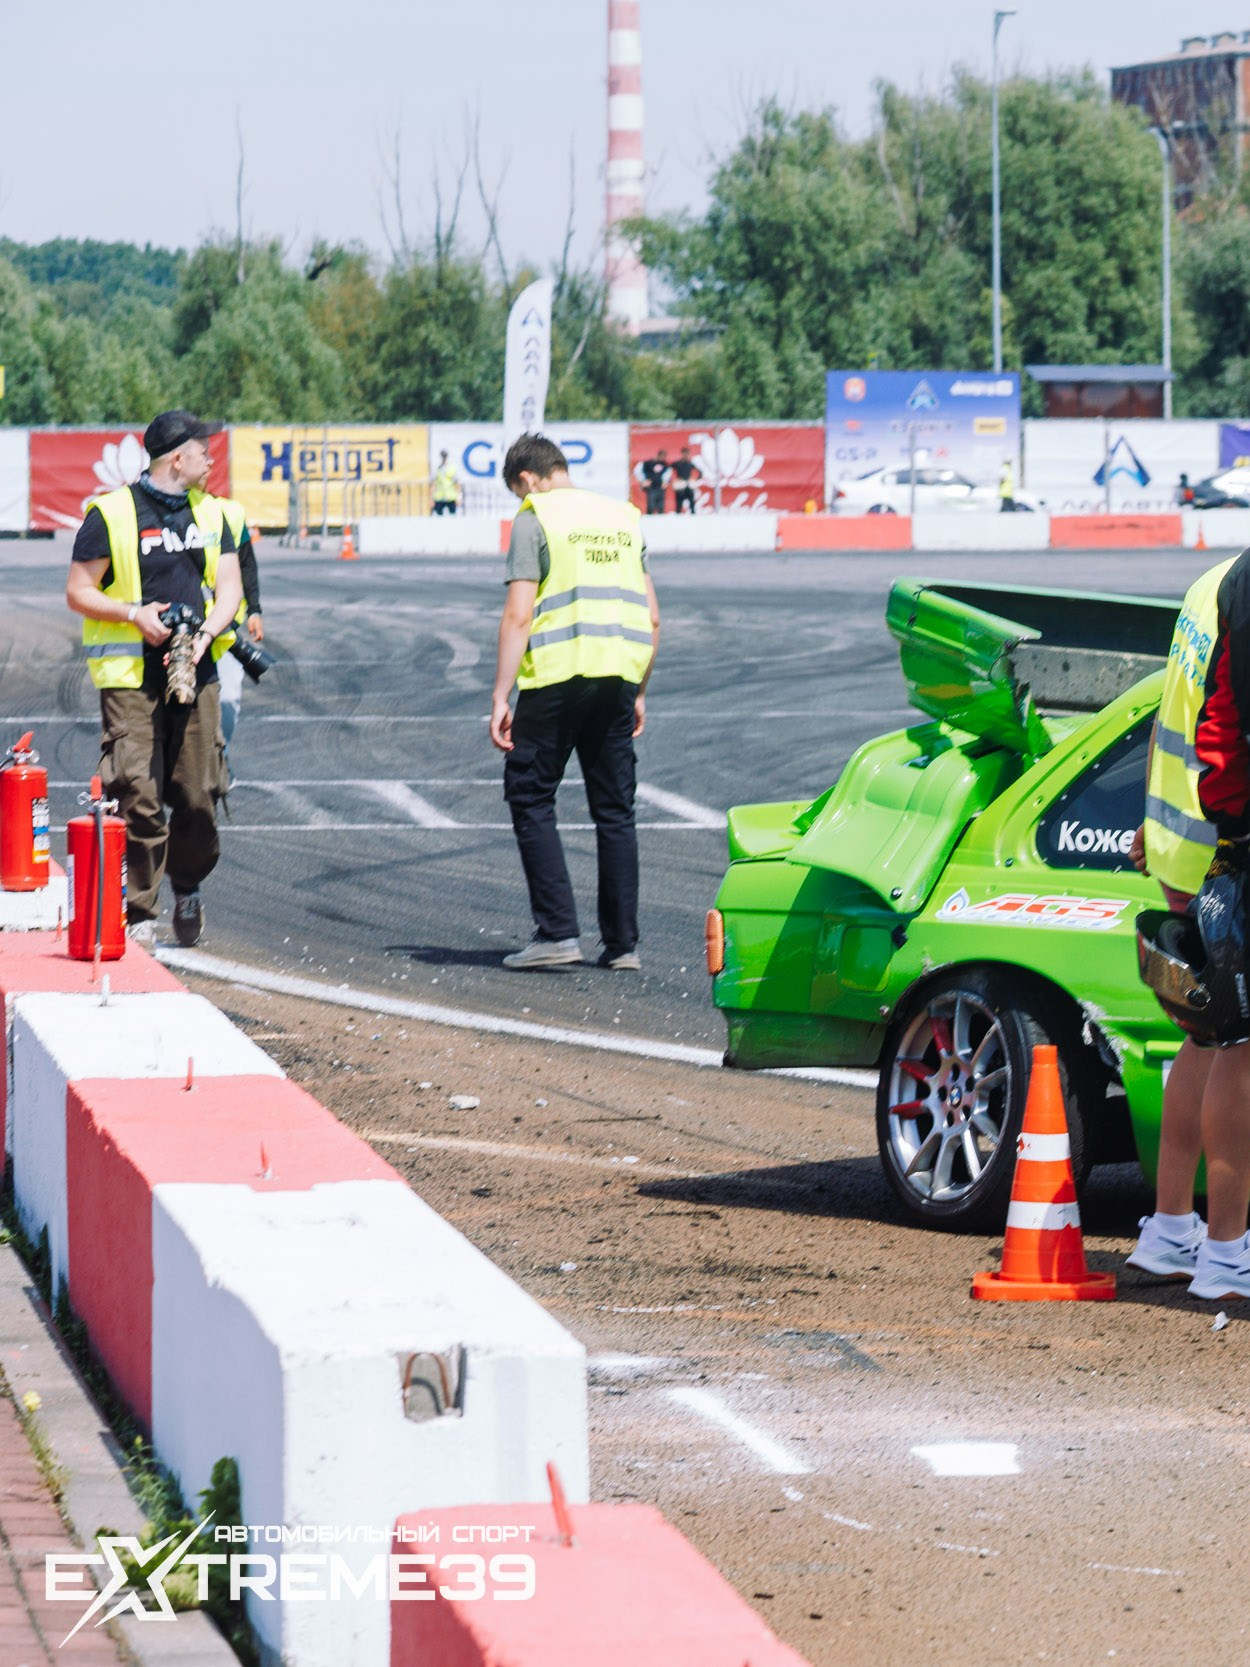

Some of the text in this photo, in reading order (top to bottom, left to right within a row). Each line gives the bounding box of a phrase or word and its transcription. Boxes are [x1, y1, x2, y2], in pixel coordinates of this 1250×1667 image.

[261, 438, 400, 481] Hengst
[463, 440, 593, 477] GP
[140, 523, 203, 555] FILA
